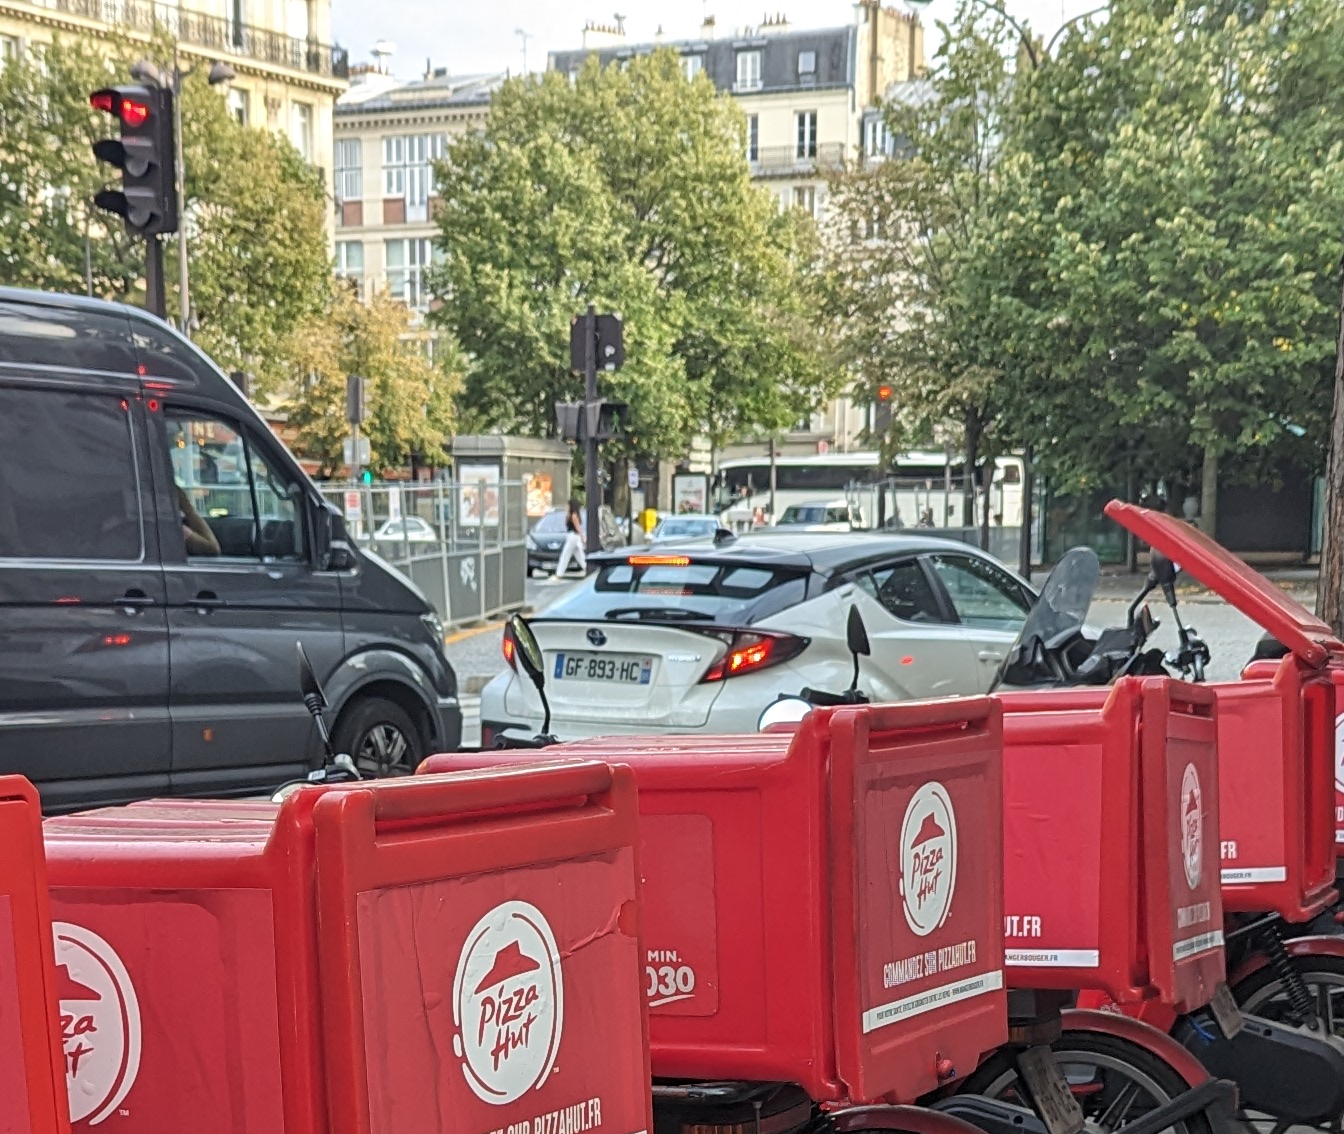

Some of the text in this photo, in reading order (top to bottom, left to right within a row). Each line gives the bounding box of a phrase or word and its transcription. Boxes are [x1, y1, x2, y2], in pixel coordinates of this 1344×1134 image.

[911, 844, 944, 890] Pizza
[917, 867, 942, 910] Hut
[647, 950, 682, 962] MIN.
[478, 984, 539, 1047] Pizza
[490, 1012, 537, 1072] Hut
